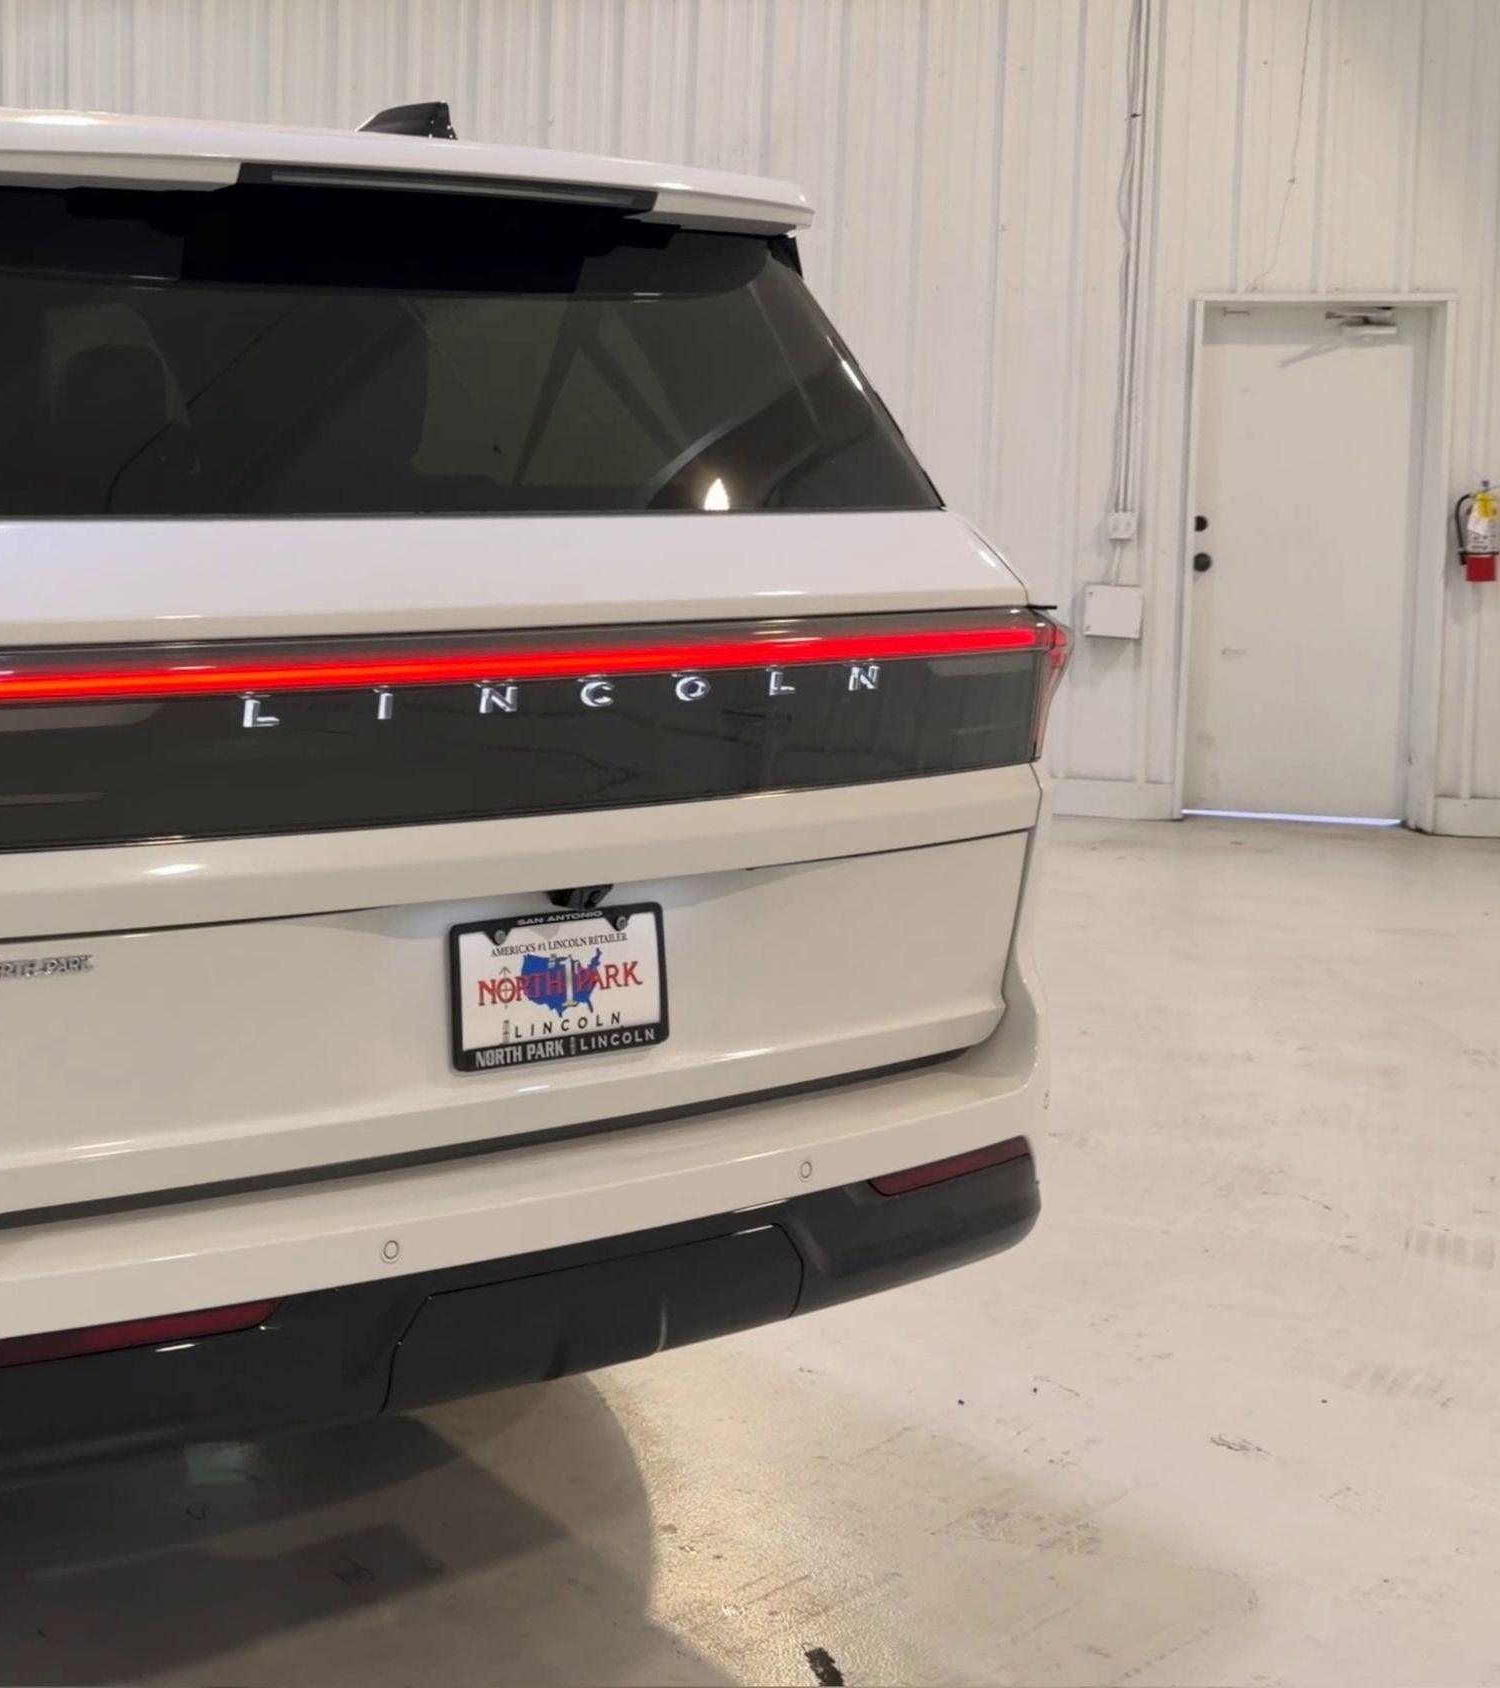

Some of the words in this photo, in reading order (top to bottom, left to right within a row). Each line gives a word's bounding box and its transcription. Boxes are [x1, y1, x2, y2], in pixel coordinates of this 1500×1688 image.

[243, 659, 881, 728] LINCOLN
[517, 917, 543, 926] SAN
[547, 910, 603, 922] ANTONIO
[491, 944, 536, 957] AMERICA'S
[537, 942, 547, 951] #1
[548, 936, 586, 950] LINCOLN
[588, 932, 628, 945] RETAILER
[478, 969, 563, 1006] NORTH
[576, 961, 644, 993] PARK
[515, 1012, 622, 1039] LINCOLN
[475, 1047, 524, 1068] NORTH
[527, 1040, 565, 1061] PARK
[580, 1028, 655, 1050] LINCOLN
